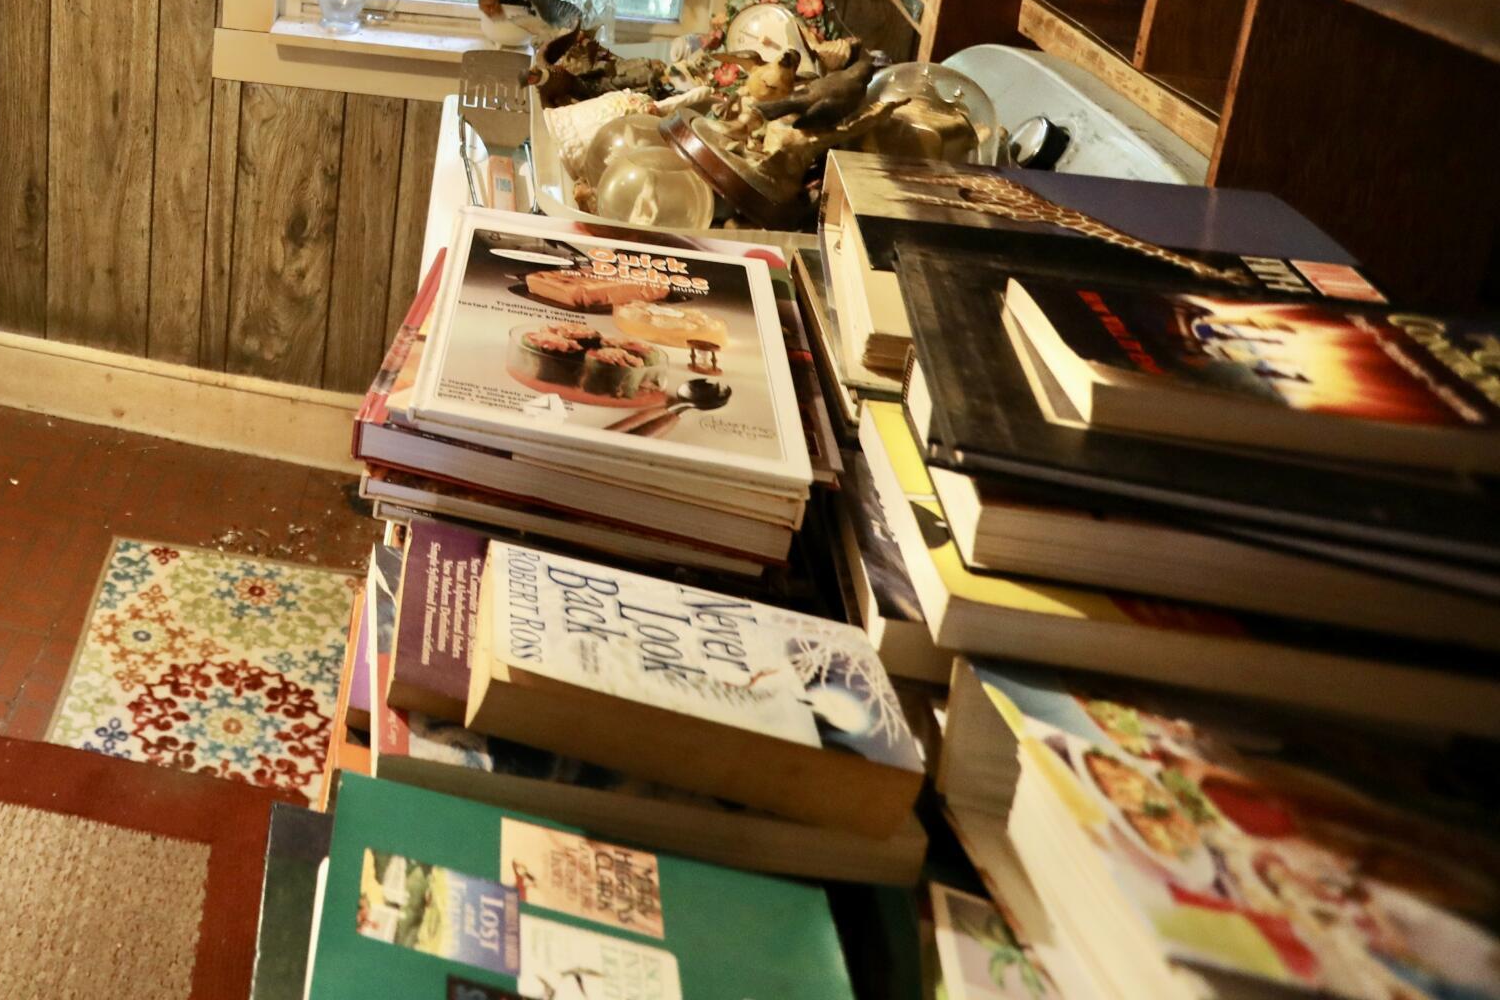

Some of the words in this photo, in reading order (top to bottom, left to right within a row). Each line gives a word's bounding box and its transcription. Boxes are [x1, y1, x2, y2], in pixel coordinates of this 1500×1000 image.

[587, 248, 690, 275] Quick
[591, 260, 711, 291] Dishes
[496, 300, 548, 314] Traditional
[550, 309, 586, 321] recipes
[545, 314, 587, 326] kitchens
[508, 547, 541, 616] ROBERT
[547, 564, 629, 643] Back
[617, 600, 706, 681] Look
[678, 586, 759, 673] Never
